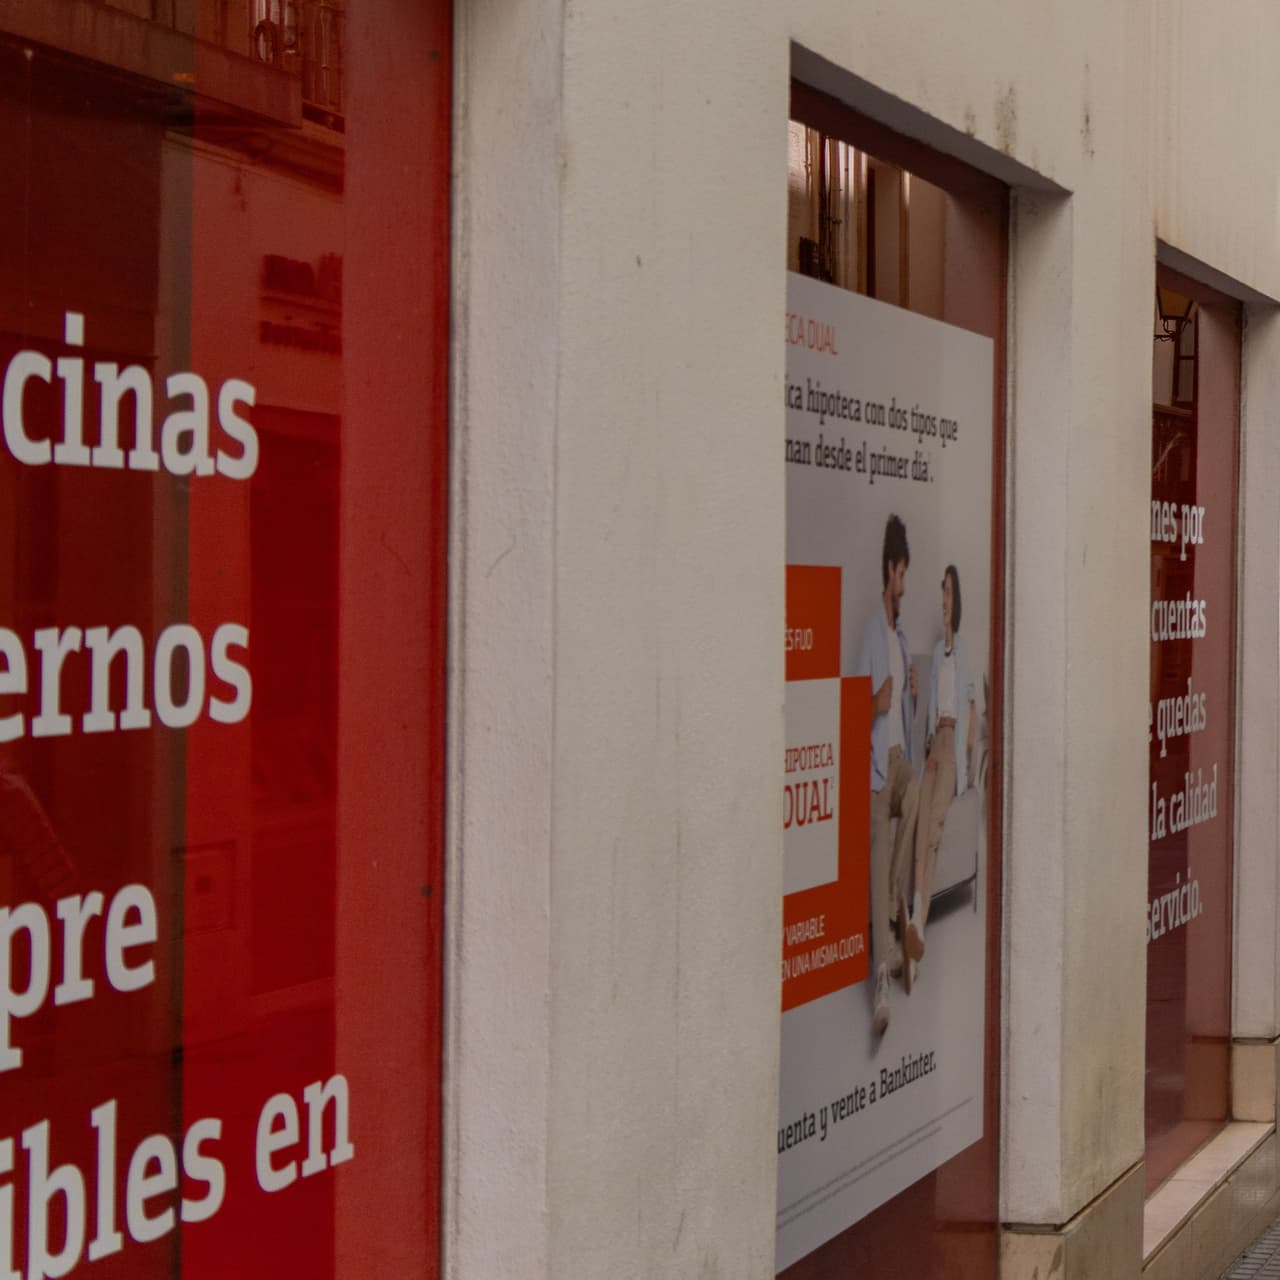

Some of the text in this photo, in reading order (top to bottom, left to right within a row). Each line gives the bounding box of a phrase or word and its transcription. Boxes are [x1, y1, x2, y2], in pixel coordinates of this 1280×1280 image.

[2, 310, 260, 480] cinas
[807, 377, 862, 426] hipoteca
[864, 400, 886, 427] con
[888, 396, 908, 431] dos
[939, 416, 958, 449] que
[815, 433, 852, 471] desde
[855, 440, 867, 473] el
[870, 445, 909, 485] primer
[1180, 503, 1206, 561] por
[1151, 590, 1207, 642] cuentas
[1157, 677, 1207, 758] quedas
[1151, 763, 1218, 841] la calidad
[255, 1074, 355, 1193] en
[819, 1105, 829, 1142] y
[831, 1084, 867, 1124] vente
[869, 1081, 876, 1105] a
[879, 1050, 937, 1099] Bankinter.
